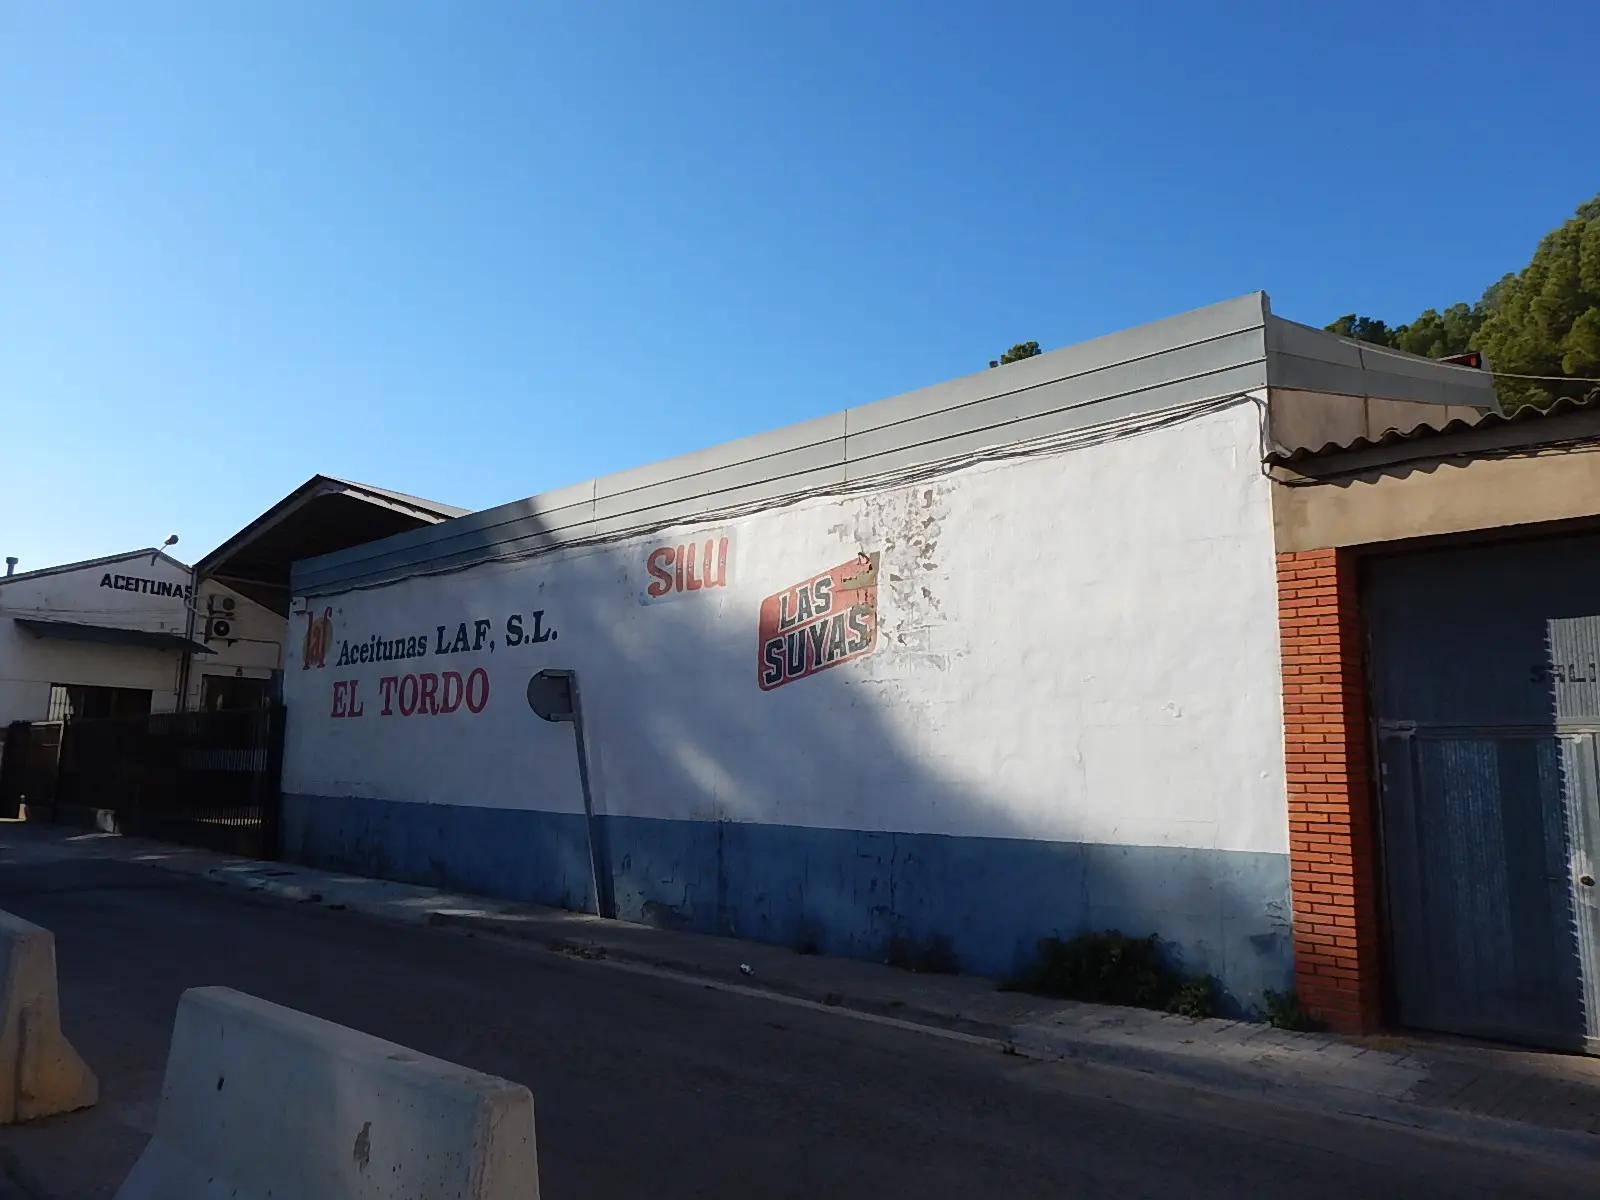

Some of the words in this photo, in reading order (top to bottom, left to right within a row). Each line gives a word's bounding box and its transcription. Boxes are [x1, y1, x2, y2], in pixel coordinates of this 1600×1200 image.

[99, 573, 193, 600] ACEITUNAS
[647, 536, 729, 598] SILU
[778, 575, 835, 632] LAS
[336, 634, 428, 667] Aceitunas
[434, 618, 496, 653] LAF,
[505, 609, 558, 647] S.L.
[762, 603, 871, 687] SUYAS
[330, 679, 364, 718] EL
[378, 667, 490, 717] TORDO
